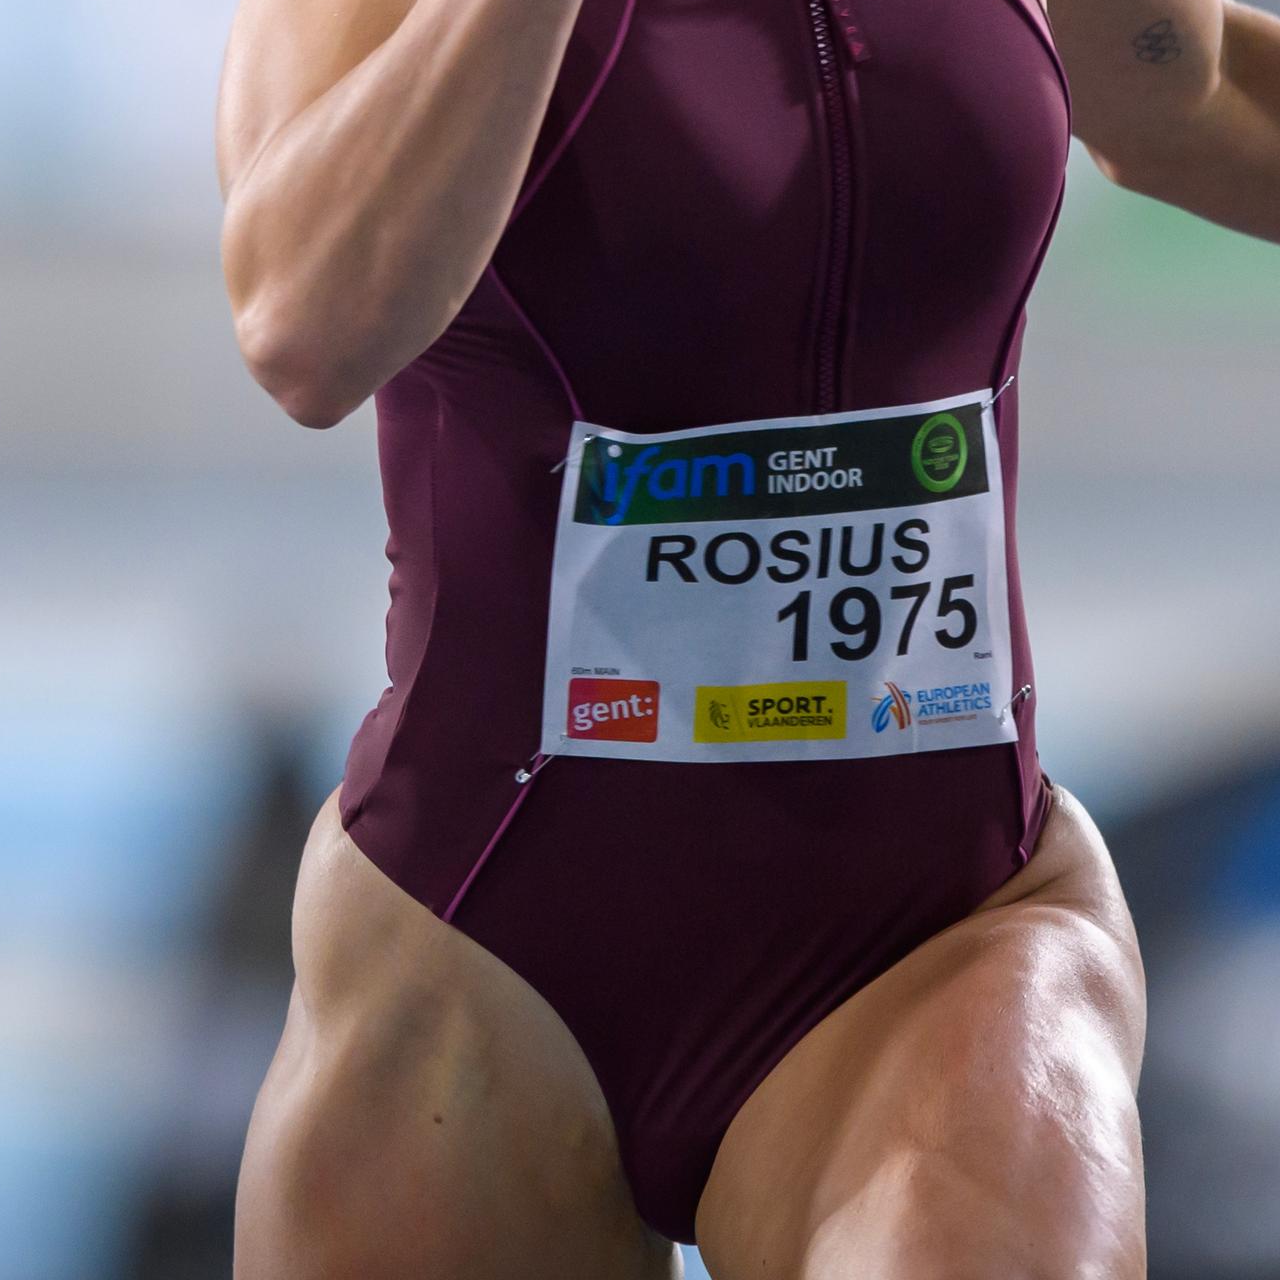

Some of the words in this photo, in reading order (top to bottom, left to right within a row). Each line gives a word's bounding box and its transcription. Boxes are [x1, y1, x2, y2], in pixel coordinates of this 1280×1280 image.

[768, 447, 838, 472] GENT
[600, 443, 756, 527] ifam
[768, 467, 864, 495] INDOOR
[645, 518, 931, 585] ROSIUS
[776, 574, 978, 662] 1975
[917, 682, 991, 703] EUROPEAN
[918, 696, 993, 717] ATHLETICS
[572, 694, 654, 732] gent:
[748, 715, 833, 729] VLAANDEREN
